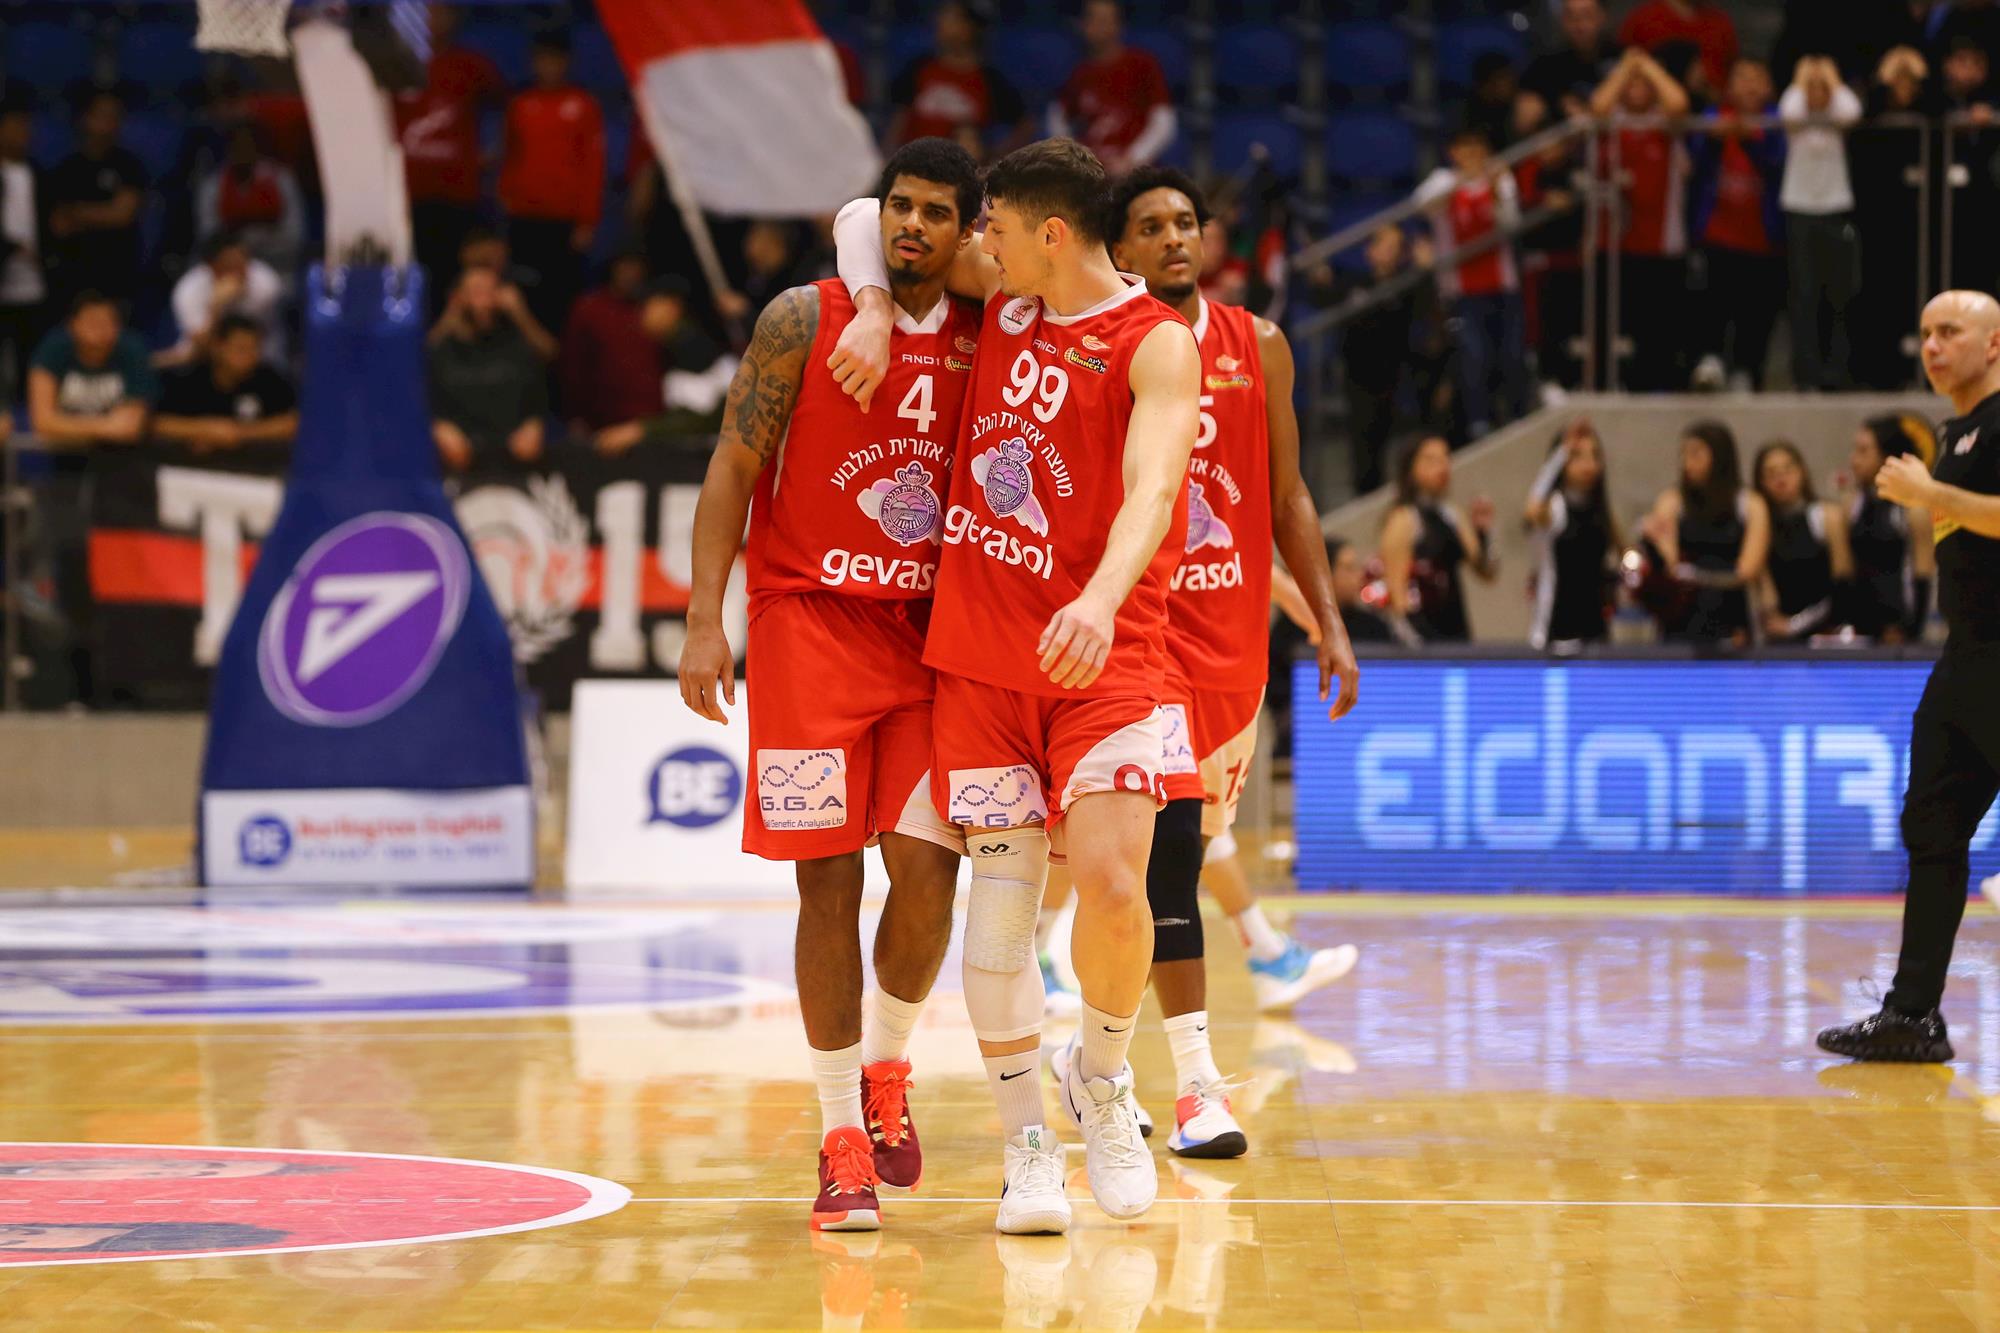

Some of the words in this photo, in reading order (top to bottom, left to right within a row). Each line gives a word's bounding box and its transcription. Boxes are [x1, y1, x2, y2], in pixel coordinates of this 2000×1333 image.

[897, 374, 937, 433] 4
[1002, 349, 1069, 423] 99
[971, 412, 998, 441] הגלב
[999, 411, 1046, 447] אזורית
[1193, 395, 1217, 448] 5
[830, 443, 884, 491] הגלבוע
[889, 438, 944, 462] אזורית
[1041, 442, 1074, 497] מועצה
[820, 548, 936, 591] gevas
[1169, 552, 1243, 591] vasol
[659, 760, 732, 817] BE
[797, 818, 831, 829] Analysis
[832, 816, 844, 826] Ltd
